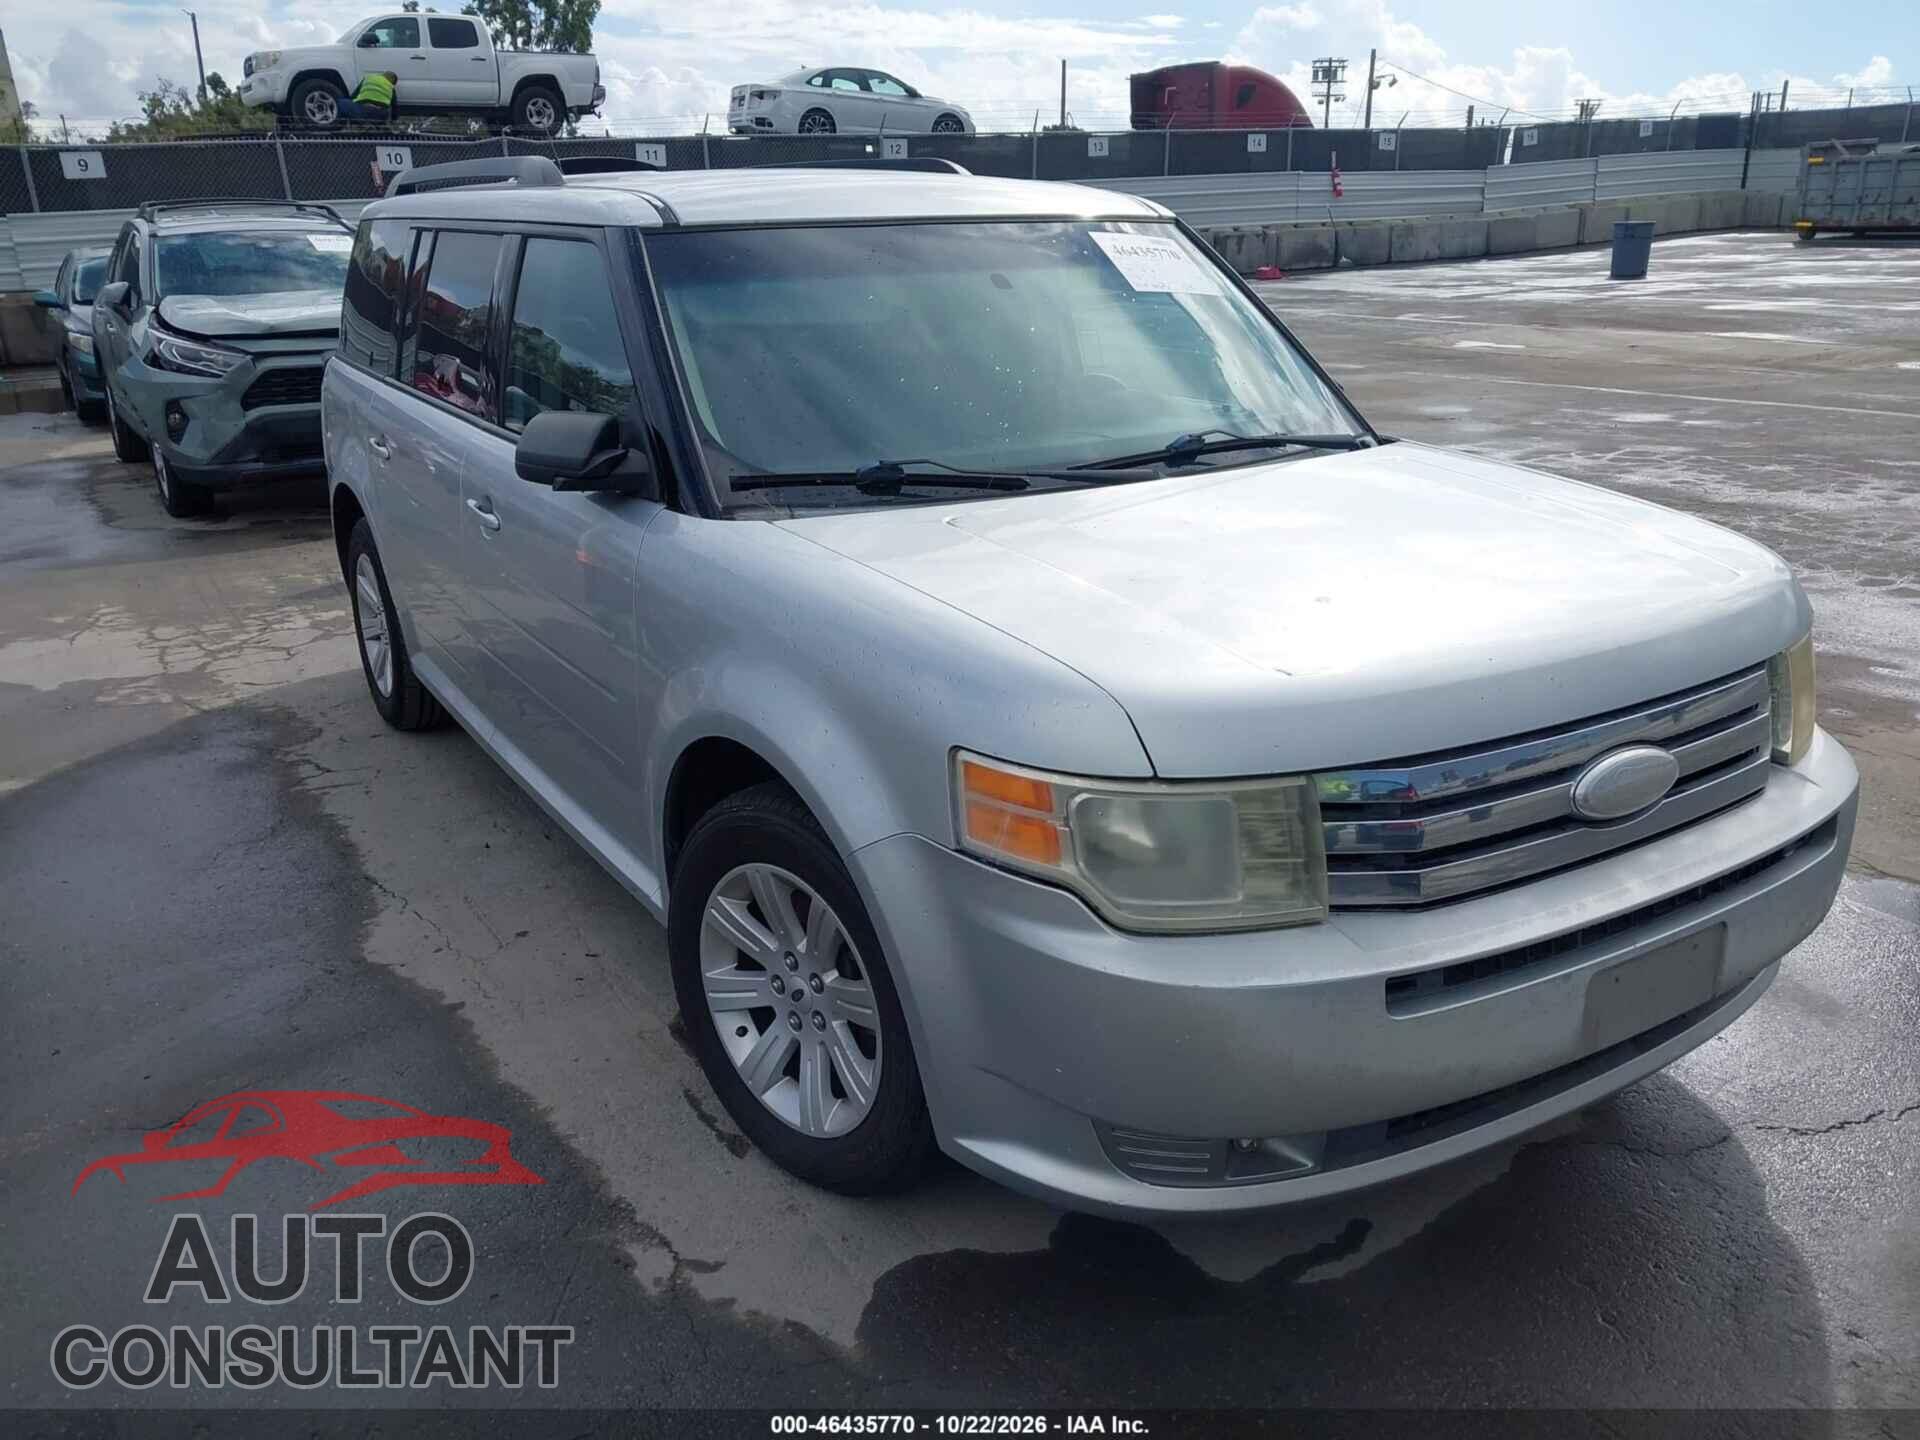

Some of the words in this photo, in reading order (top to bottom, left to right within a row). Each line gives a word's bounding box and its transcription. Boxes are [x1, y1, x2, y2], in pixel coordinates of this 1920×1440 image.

[1093, 141, 1104, 152] 13
[1252, 138, 1262, 149] 14
[1383, 136, 1393, 146] 15
[645, 149, 658, 161] 11
[889, 143, 902, 155] 12
[386, 152, 404, 165] 10
[78, 158, 89, 172] 9
